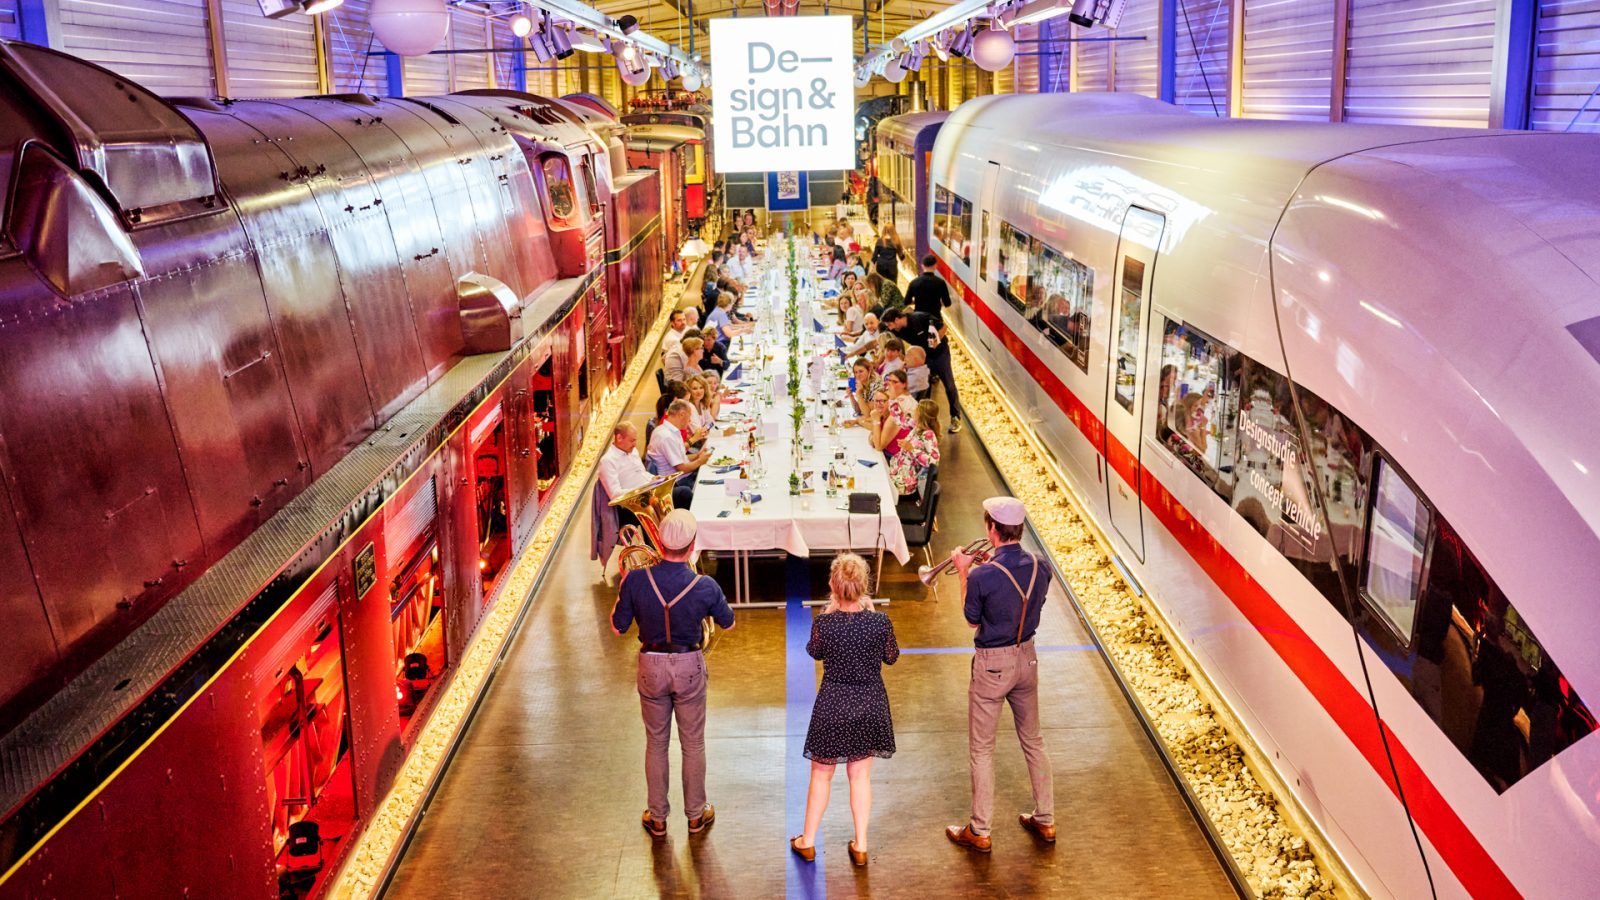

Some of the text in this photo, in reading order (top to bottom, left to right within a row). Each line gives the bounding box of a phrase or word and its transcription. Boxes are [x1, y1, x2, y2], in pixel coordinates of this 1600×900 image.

[731, 113, 828, 149] Bahn
[1239, 410, 1296, 469] Designstudie
[1250, 469, 1321, 540] concept vehicle
